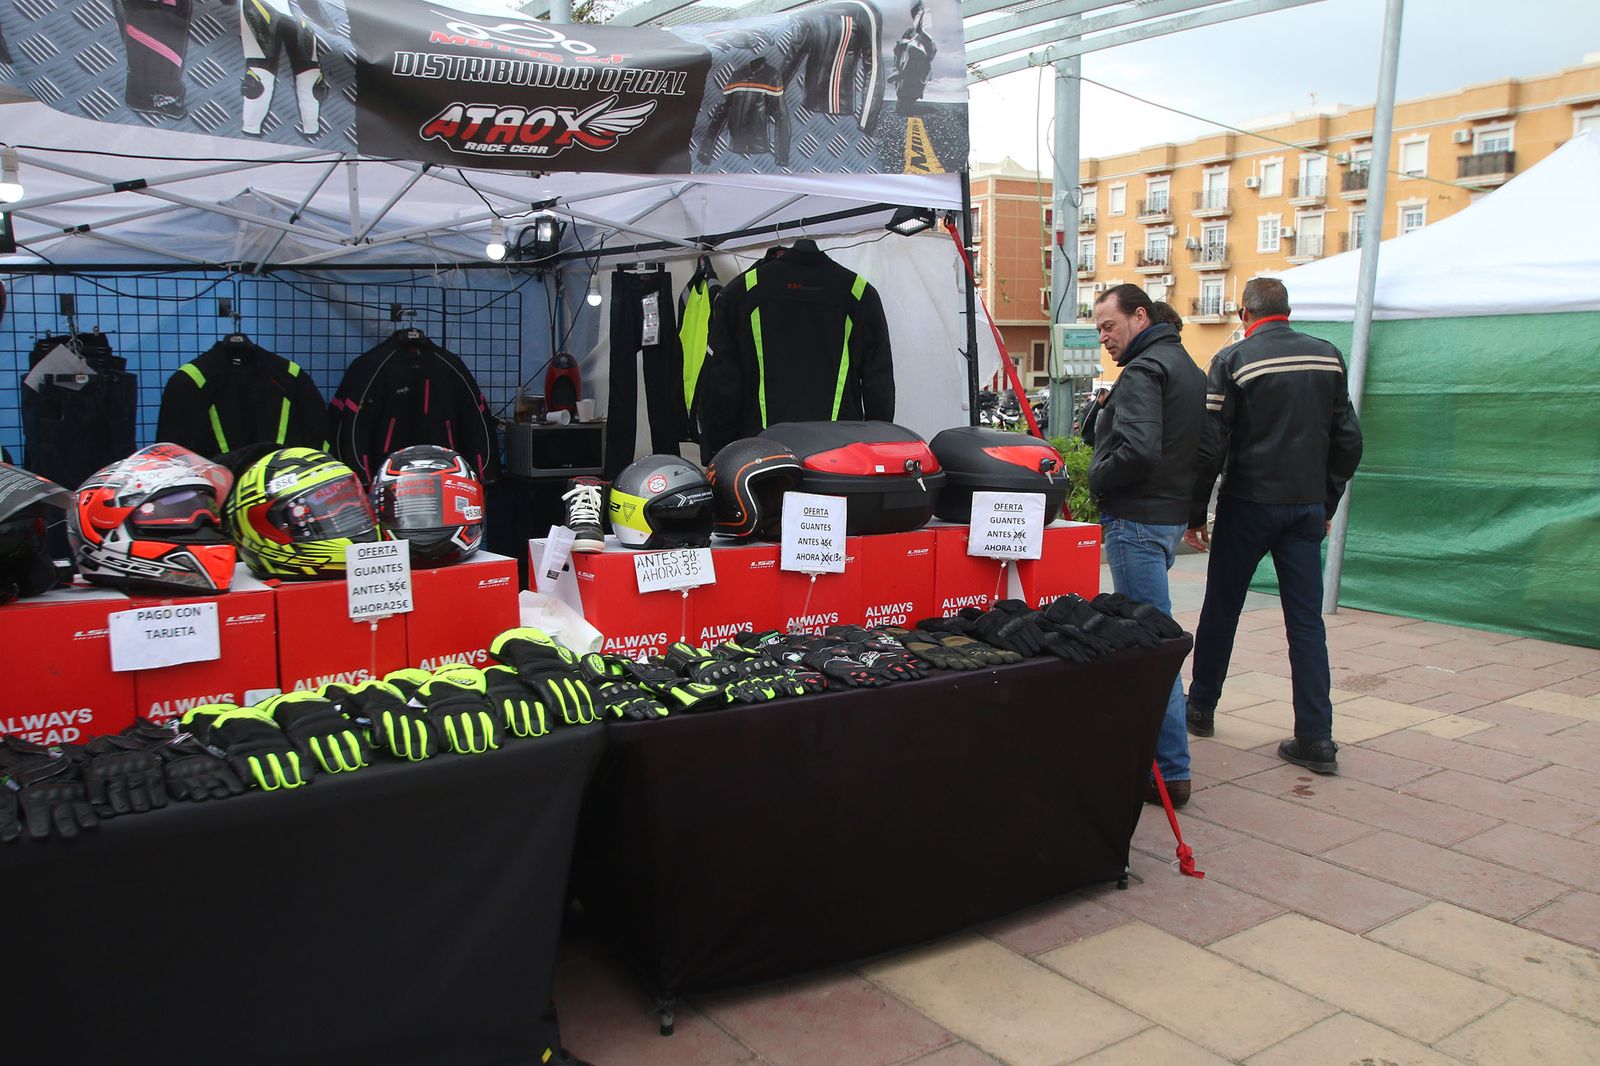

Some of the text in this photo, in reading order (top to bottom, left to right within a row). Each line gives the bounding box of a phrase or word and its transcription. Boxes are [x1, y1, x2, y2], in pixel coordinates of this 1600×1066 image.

[392, 51, 688, 96] DISTRIBUIDOR OFICIAL
[423, 105, 602, 147] ATROX
[465, 141, 506, 153] RACE
[803, 507, 829, 518] OFERTA
[993, 503, 1023, 512] OFERTA
[800, 522, 832, 531] GUANTES
[989, 516, 1026, 525] GUANTES
[987, 530, 1012, 538] ANTES
[797, 537, 820, 546] ANTES
[357, 546, 398, 558] OFERTA
[984, 543, 1028, 553] AHORA 13€
[795, 552, 819, 561] AHORA
[354, 564, 403, 577] GUANTES
[352, 584, 386, 596] ANTES
[941, 594, 988, 609] ALWAYS
[136, 606, 202, 622] PAGO CON
[864, 602, 914, 618] ALWAYS
[785, 612, 839, 629] ALWAYS
[864, 614, 907, 629] AHEAD
[145, 625, 197, 640] TARJETA
[700, 621, 753, 640] ALWAYS
[604, 632, 668, 651] ALWAYS
